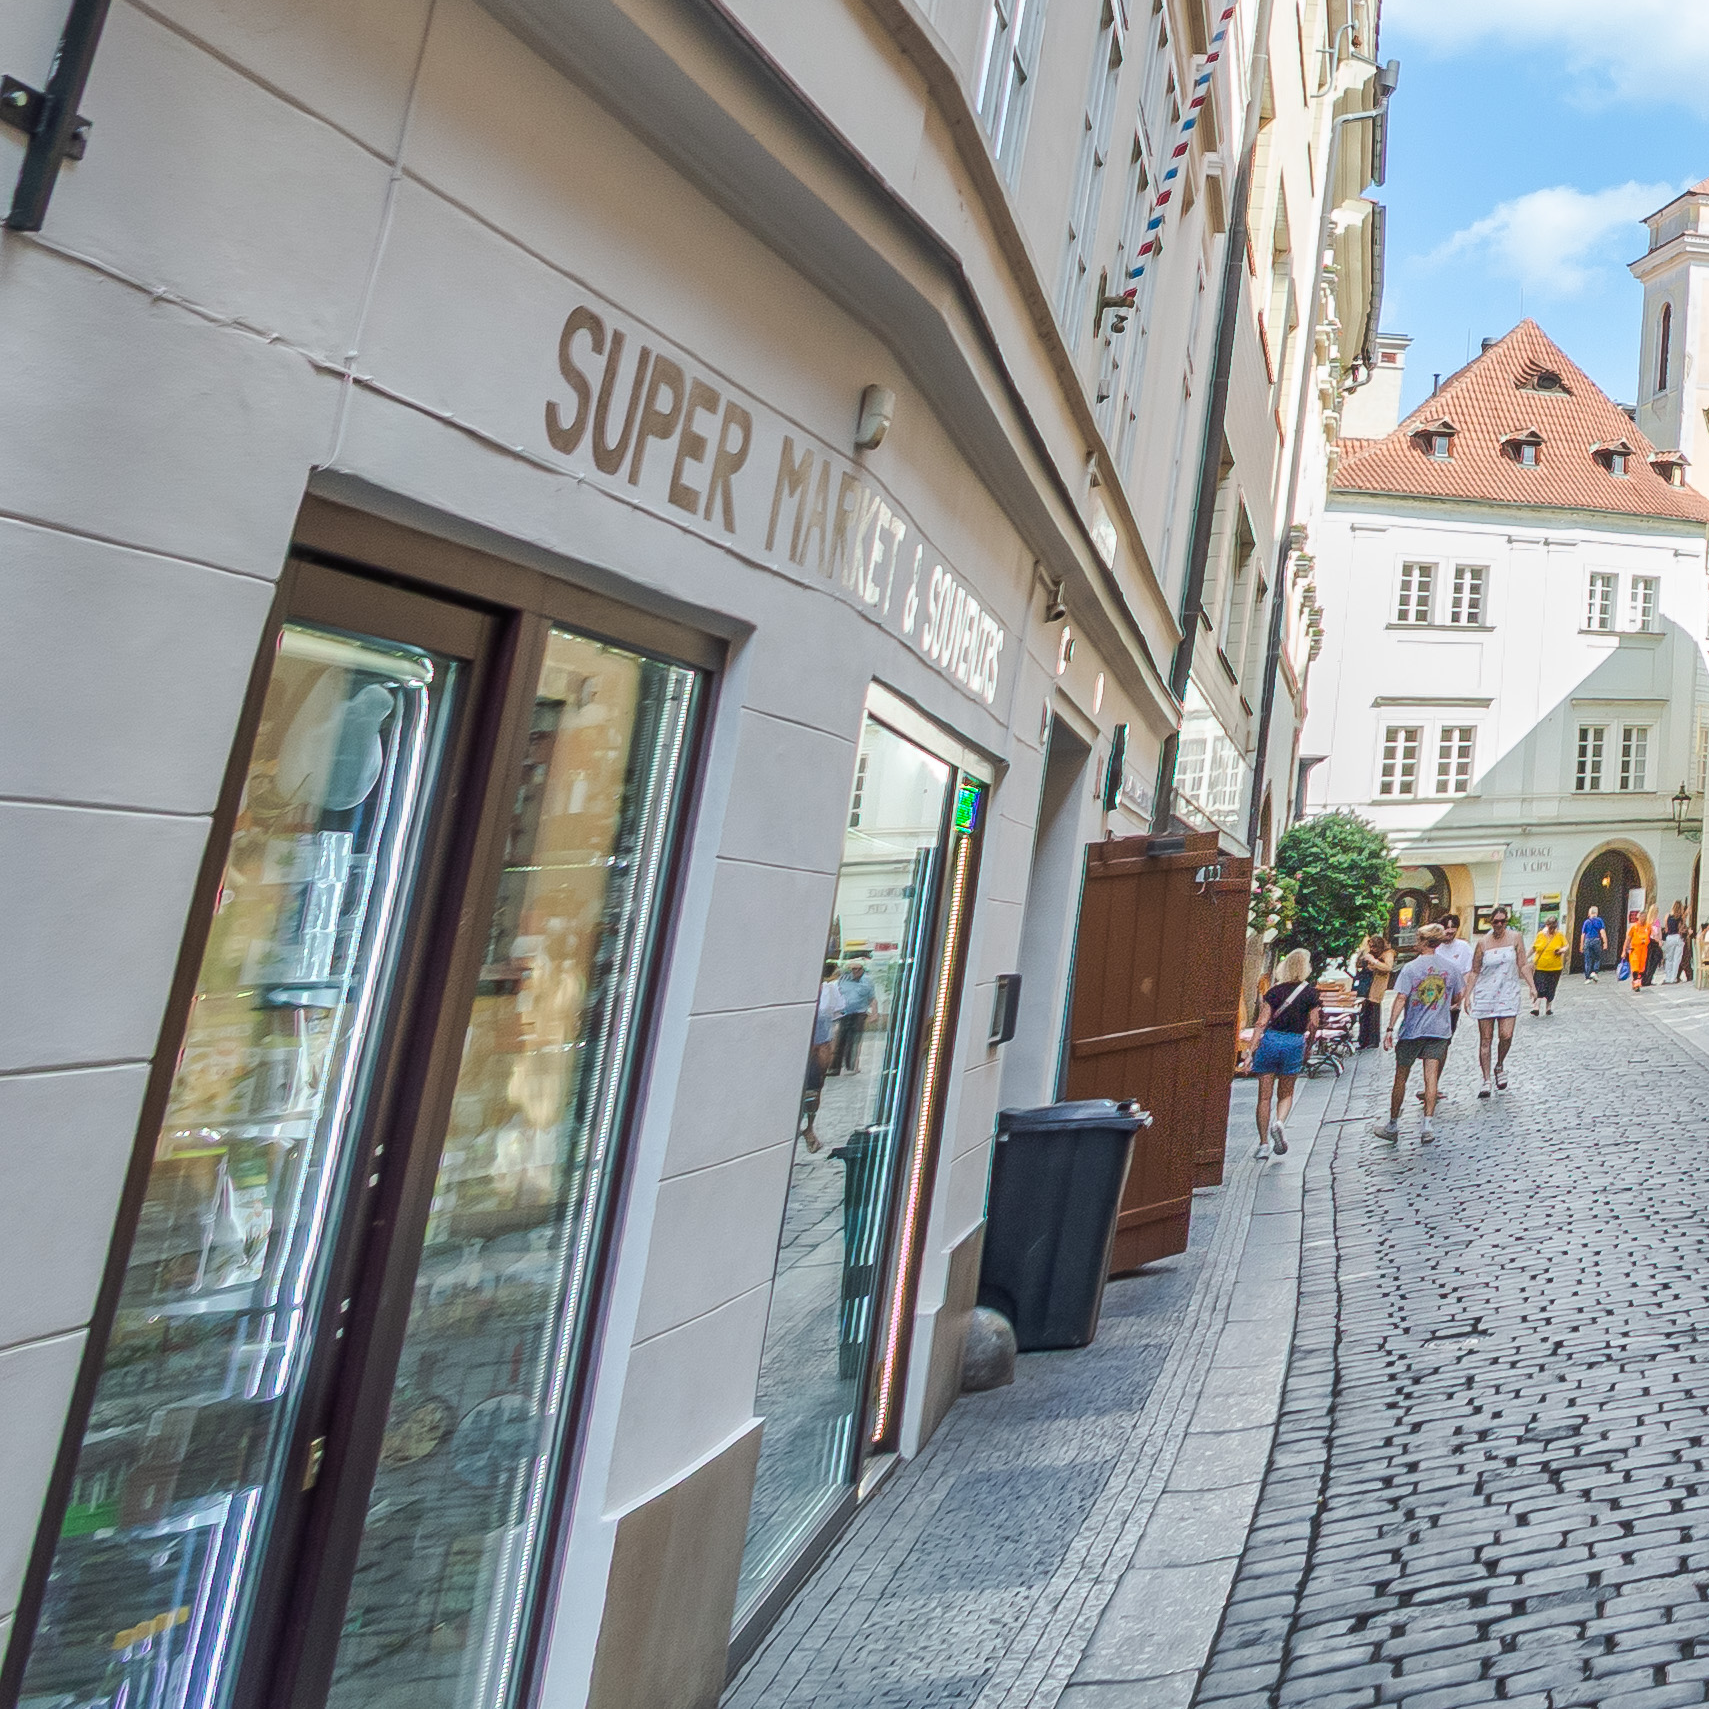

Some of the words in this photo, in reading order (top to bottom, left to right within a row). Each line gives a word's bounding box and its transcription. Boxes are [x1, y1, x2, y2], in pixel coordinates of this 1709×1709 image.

[545, 305, 753, 534] SUPER
[765, 434, 906, 617] MARKET
[903, 543, 923, 635] &
[921, 564, 1004, 704] SOUVENIRS
